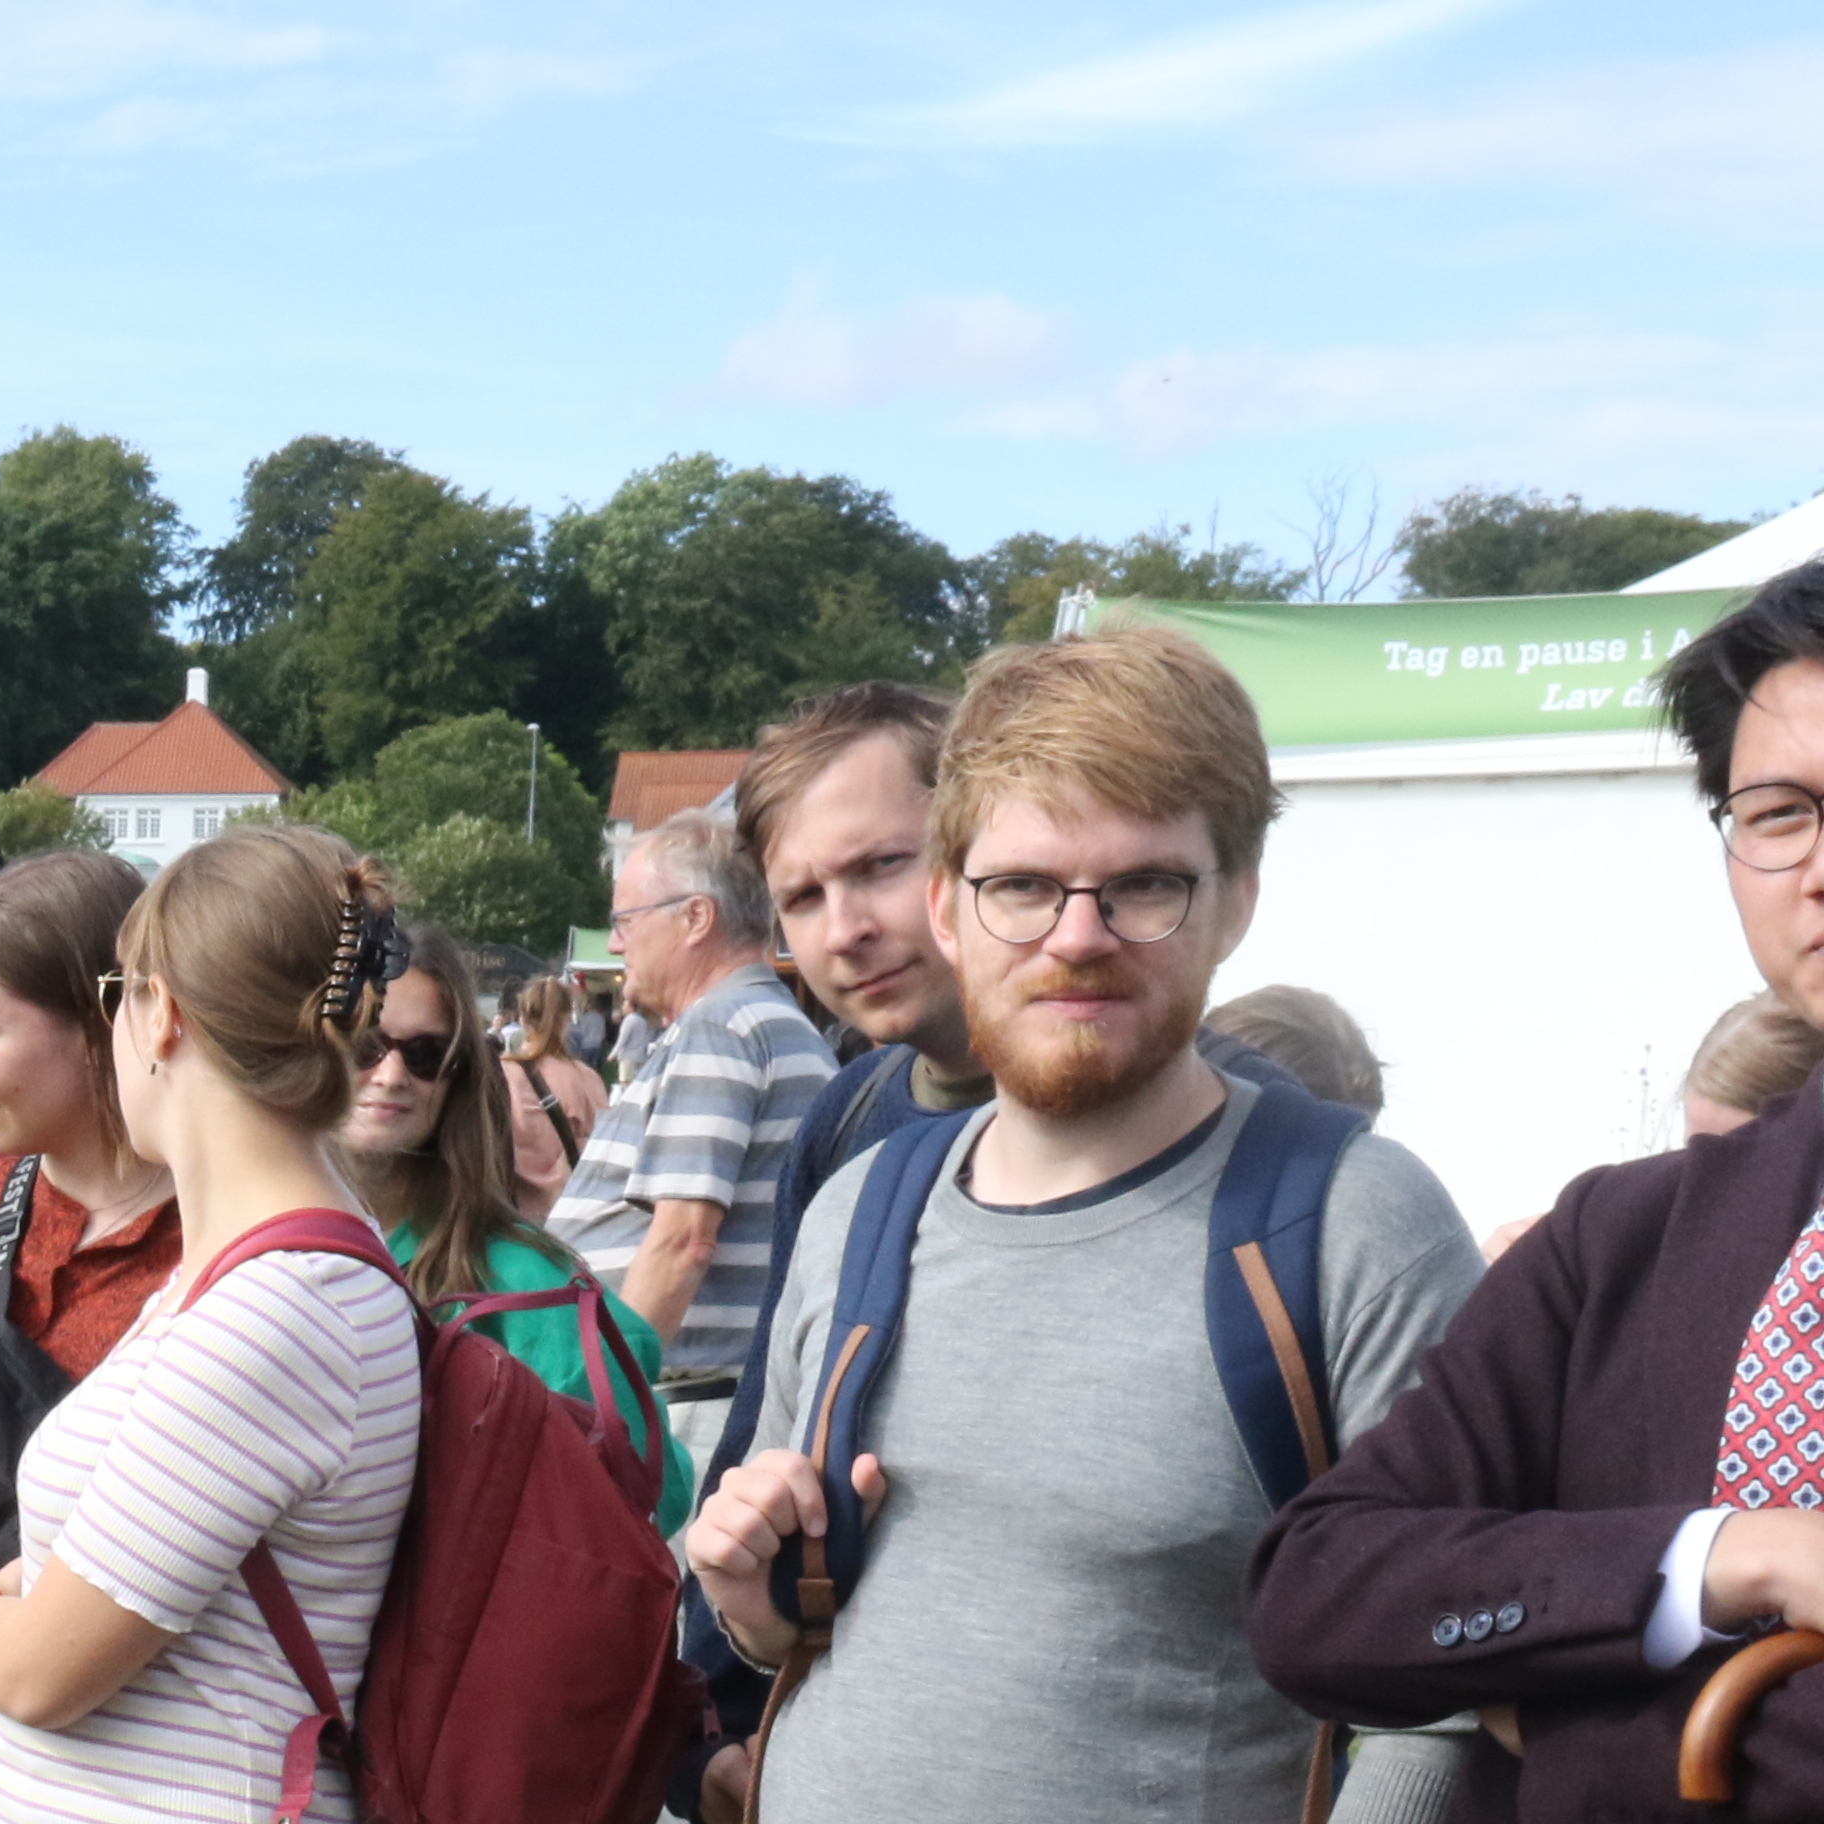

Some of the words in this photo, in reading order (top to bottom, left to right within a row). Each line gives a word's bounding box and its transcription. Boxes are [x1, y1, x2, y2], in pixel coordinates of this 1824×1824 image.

[1383, 640, 1449, 677] Tag
[1460, 644, 1505, 668] en
[1517, 638, 1627, 674] pause
[1640, 629, 1654, 660] i
[1540, 683, 1614, 712] Lav
